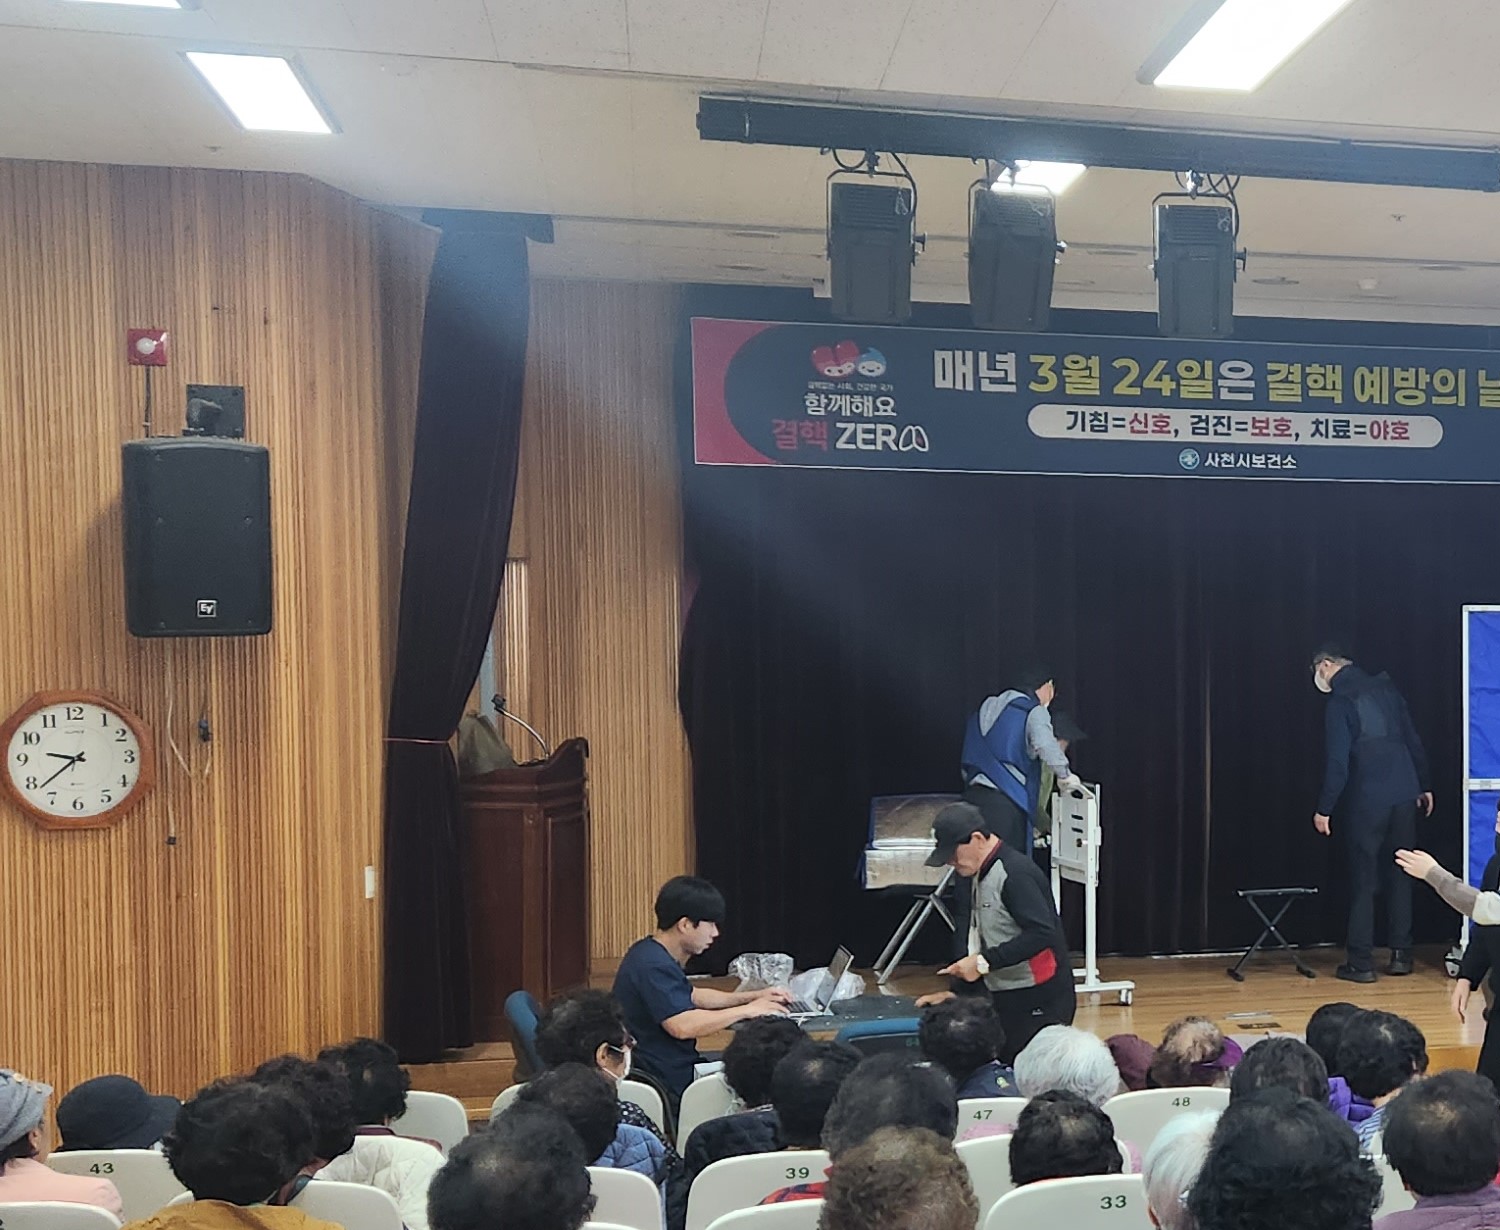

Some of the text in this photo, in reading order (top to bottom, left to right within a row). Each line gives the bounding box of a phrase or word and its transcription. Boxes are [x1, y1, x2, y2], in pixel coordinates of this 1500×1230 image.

[934, 349, 1017, 393] 매년
[1028, 353, 1100, 395] 3월
[1112, 357, 1255, 401] 24일은
[1266, 361, 1343, 403] 결핵
[1353, 366, 1466, 407] 예방의
[804, 392, 897, 417] 함께해요
[1066, 410, 1411, 441] 기침=신호, 검진=보호, 치료=야호
[772, 419, 829, 452] 결핵
[1204, 452, 1298, 470] 사천시보건소
[65, 707, 84, 720] 12
[100, 713, 108, 727] 1
[42, 715, 56, 728] 11
[23, 731, 40, 745] 10
[115, 729, 127, 742] 2
[16, 753, 29, 766] 9
[124, 749, 135, 763] 3
[25, 776, 38, 790] 8
[117, 774, 129, 787] 4
[47, 791, 57, 805] 7
[72, 796, 84, 810] 6
[101, 789, 112, 803] 5
[1171, 1097, 1190, 1107] 48
[973, 1110, 993, 1120] 47
[90, 1163, 114, 1174] 43
[785, 1167, 810, 1179] 39
[1100, 1195, 1127, 1209] 33
